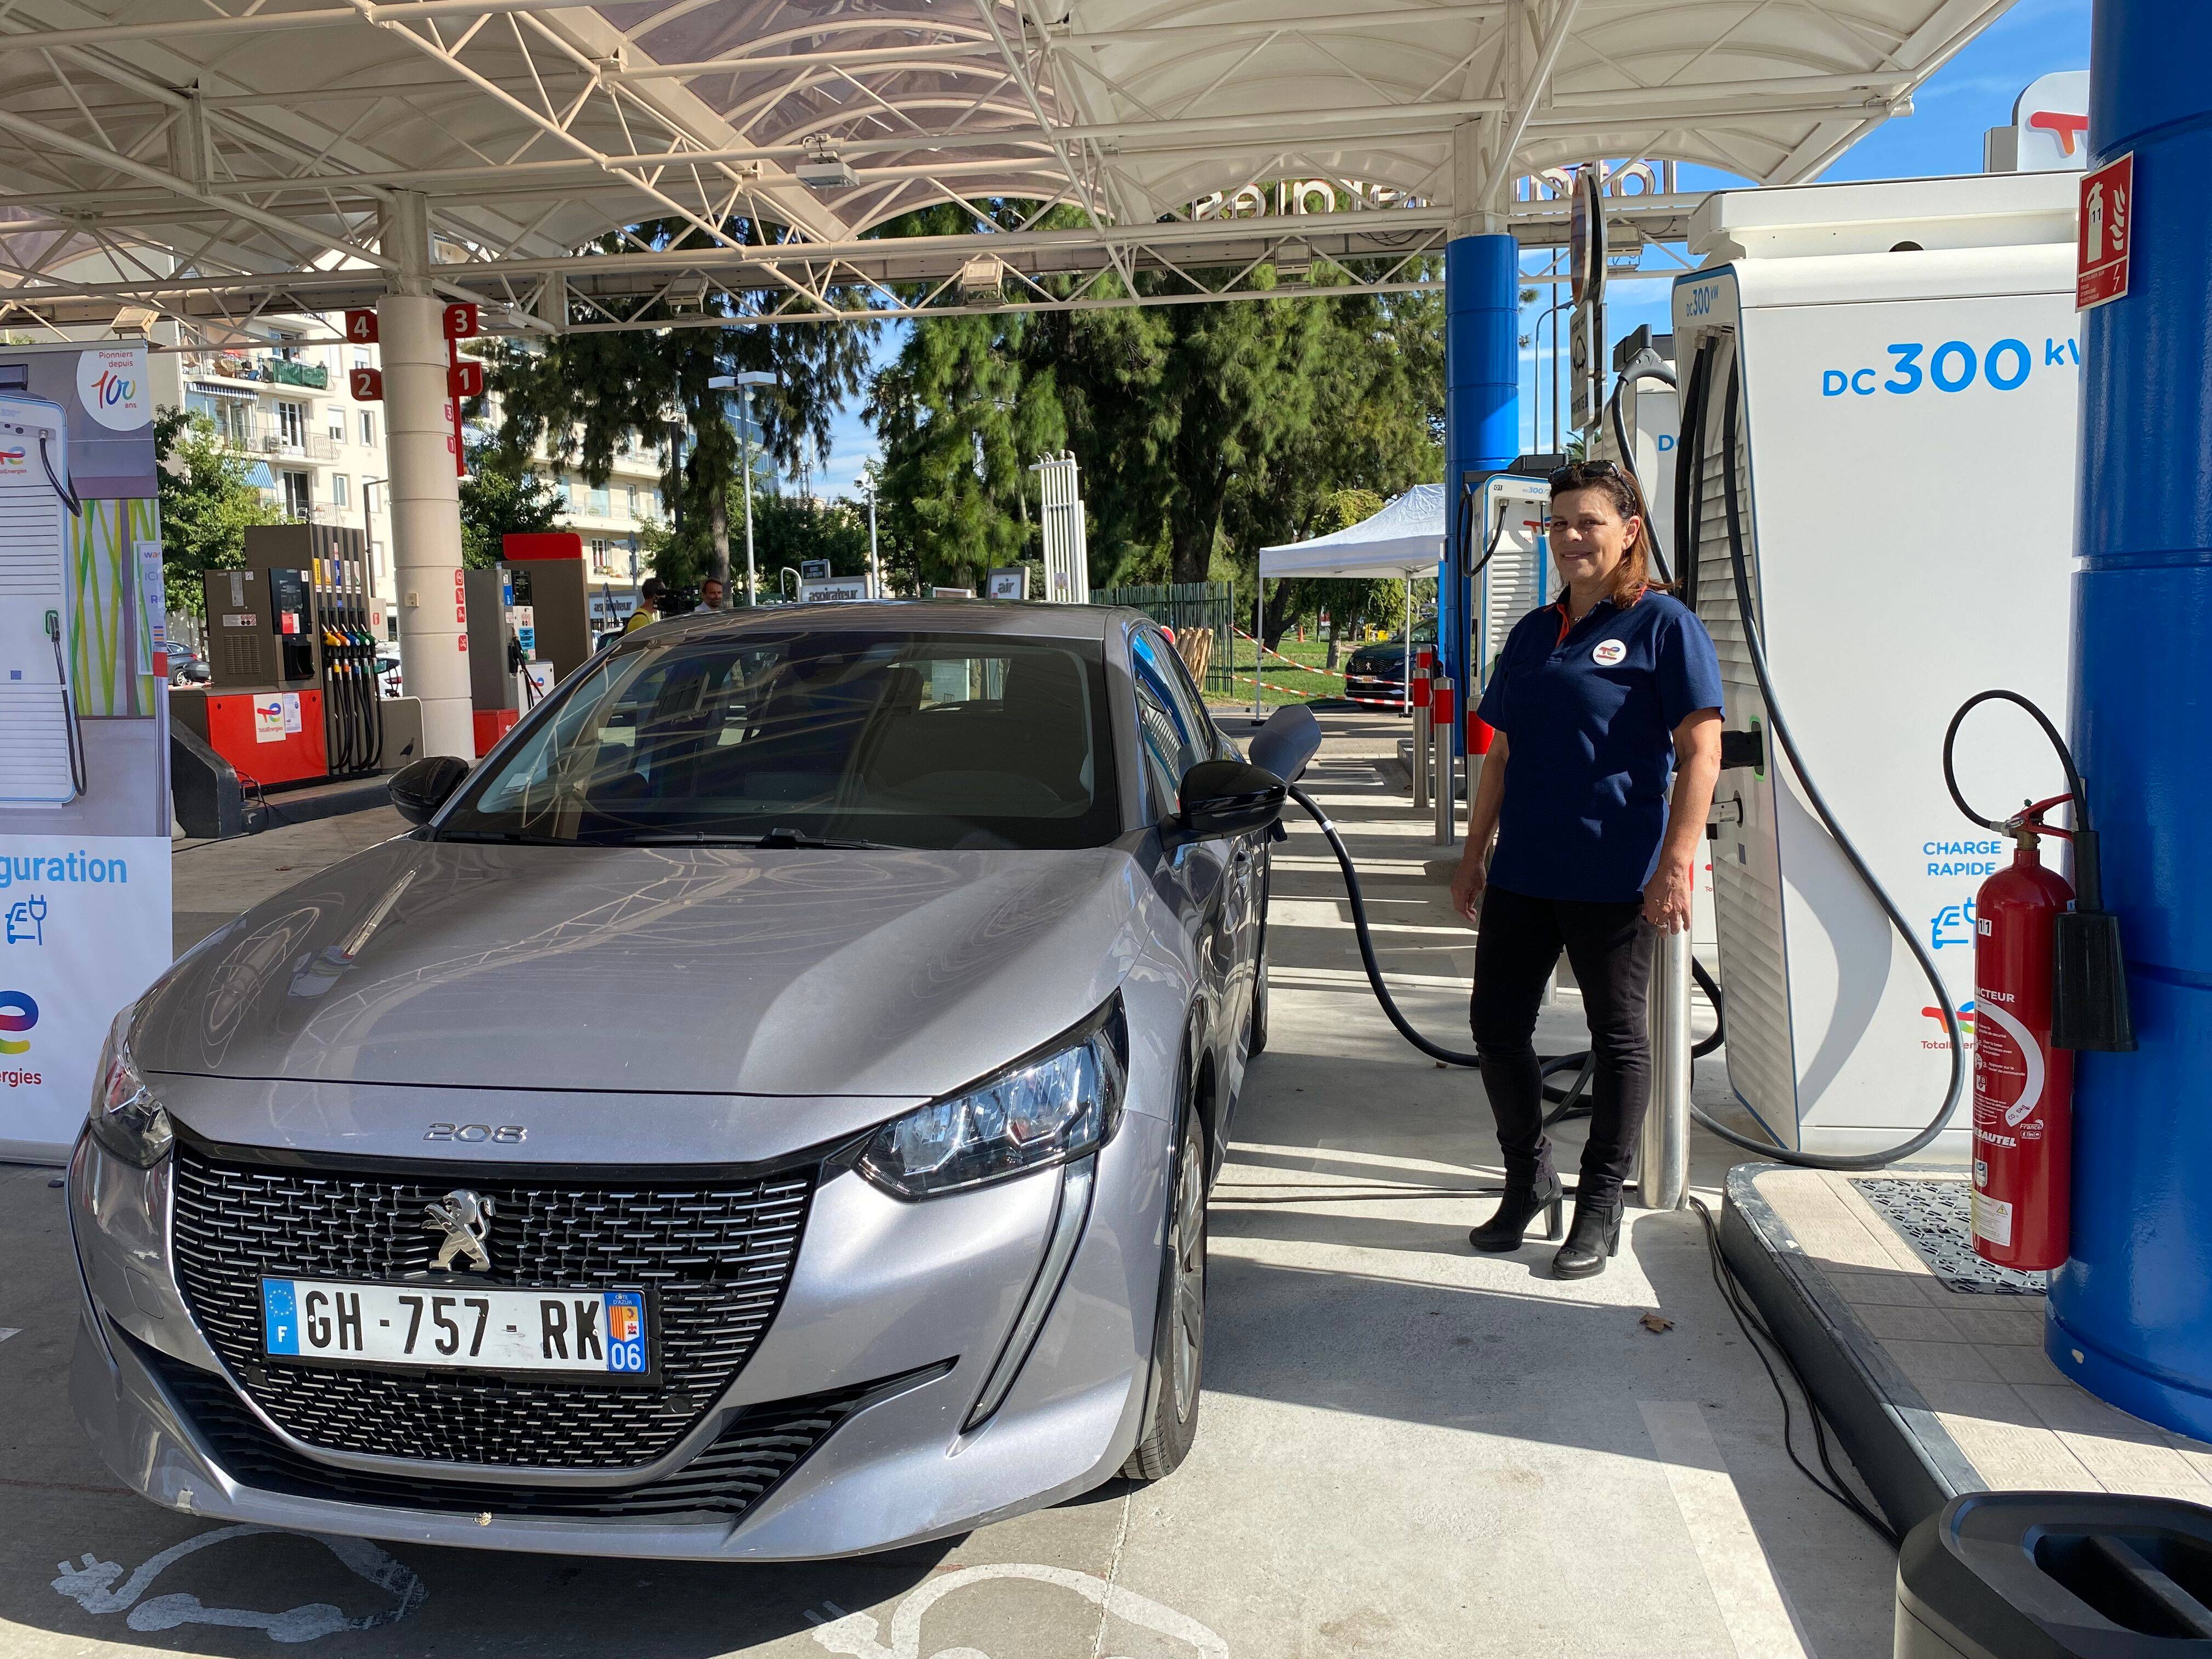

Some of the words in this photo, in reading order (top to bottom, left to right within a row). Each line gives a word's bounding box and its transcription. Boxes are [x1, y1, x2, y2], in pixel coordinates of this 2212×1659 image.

[1686, 302, 1692, 317] DC
[1693, 286, 1709, 315] 300
[1710, 285, 1718, 300] kW
[353, 316, 370, 337] 4
[454, 309, 469, 332] 3
[109, 360, 133, 368] depuis
[1823, 369, 1876, 396] DC
[1884, 338, 2032, 394] 300
[358, 374, 373, 396] 2
[459, 368, 469, 390] 1
[447, 407, 453, 420] 3
[809, 588, 857, 601] aspirateur
[997, 578, 1014, 594] air
[1923, 841, 2001, 855] CHARGE
[1927, 862, 1996, 876] RAPIDE
[423, 1123, 528, 1144] 208
[278, 1325, 287, 1343] F
[611, 1342, 641, 1370] 06
